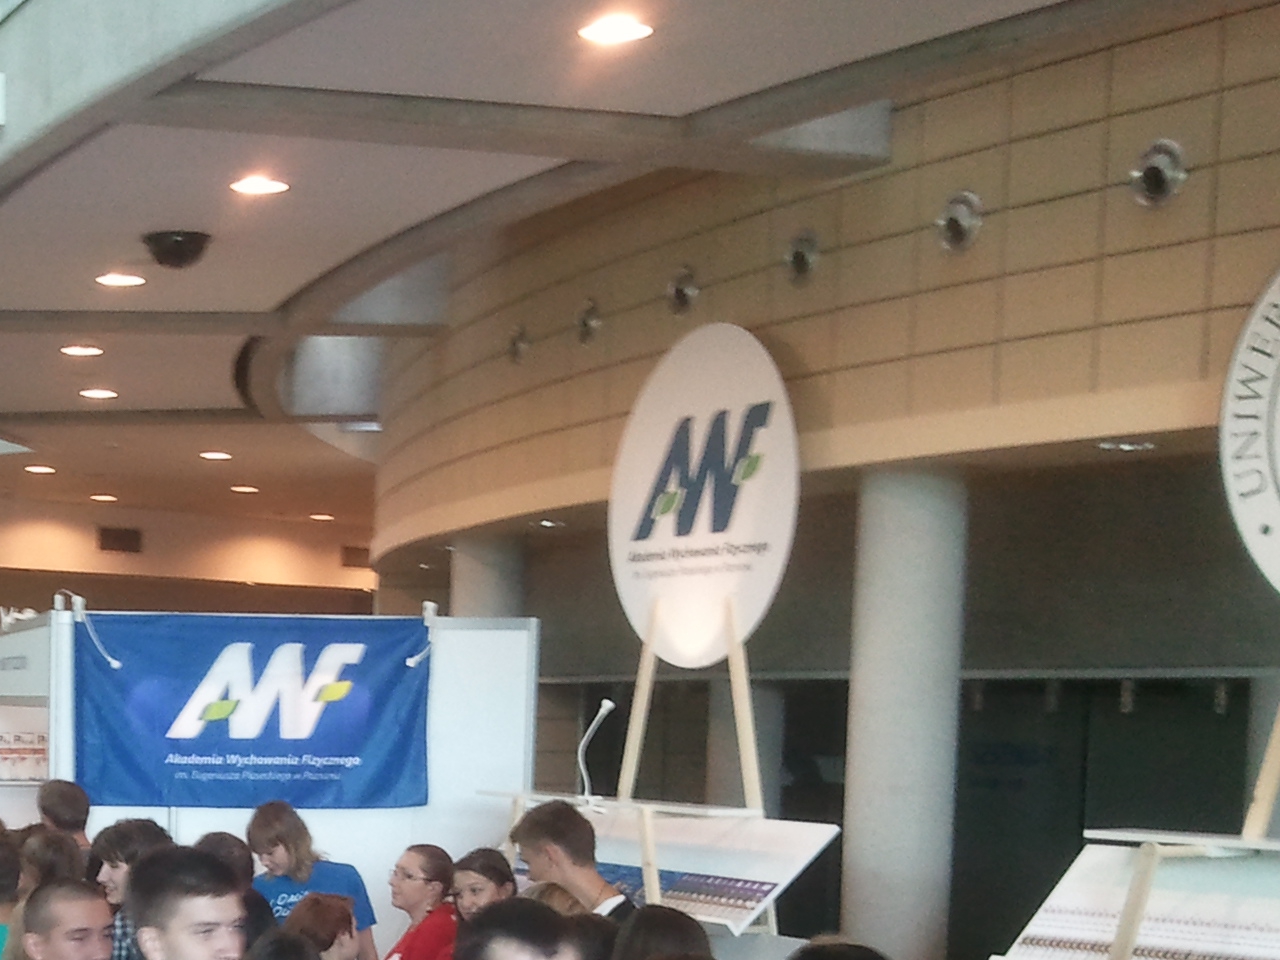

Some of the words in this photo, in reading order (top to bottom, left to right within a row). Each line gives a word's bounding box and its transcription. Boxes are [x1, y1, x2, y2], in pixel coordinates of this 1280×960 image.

[165, 753, 223, 766] Akademia
[225, 753, 299, 767] Wychowania
[302, 754, 362, 768] Fizycznego
